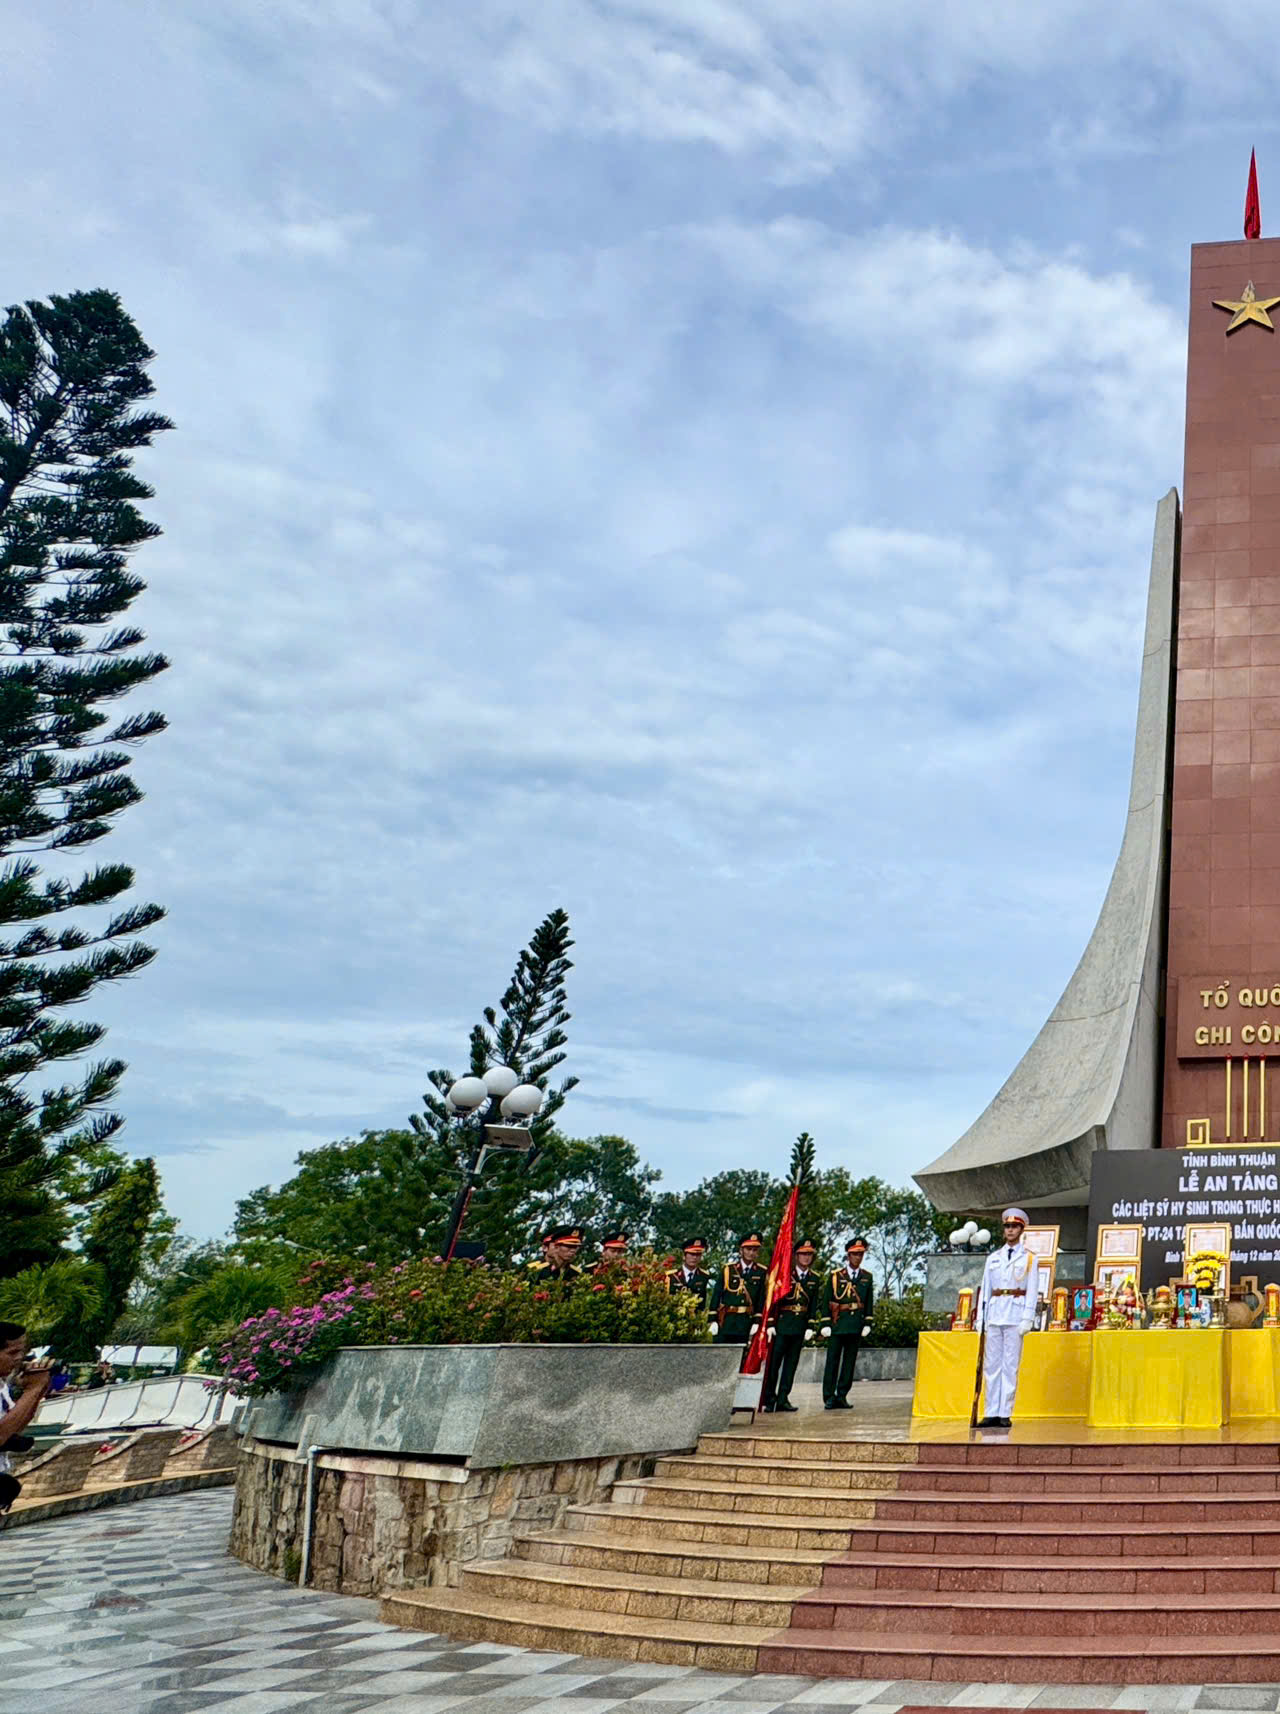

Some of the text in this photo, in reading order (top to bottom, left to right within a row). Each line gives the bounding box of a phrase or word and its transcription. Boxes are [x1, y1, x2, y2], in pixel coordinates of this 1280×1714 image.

[1200, 980, 1230, 1008] TỔ
[1195, 1026, 1232, 1045] GHI
[1182, 1151, 1276, 1169] TỈNH BÌNH THUẬN
[1179, 1169, 1278, 1193] LỄ AN TÁNG
[1112, 1199, 1132, 1217] CÁC
[1133, 1199, 1155, 1220] LIỆT
[1171, 1201, 1185, 1216] HY
[1186, 1200, 1210, 1216] SINH
[1211, 1200, 1244, 1216] TRONG
[1245, 1197, 1271, 1218] THỰC
[1147, 1226, 1174, 1241] PT-24
